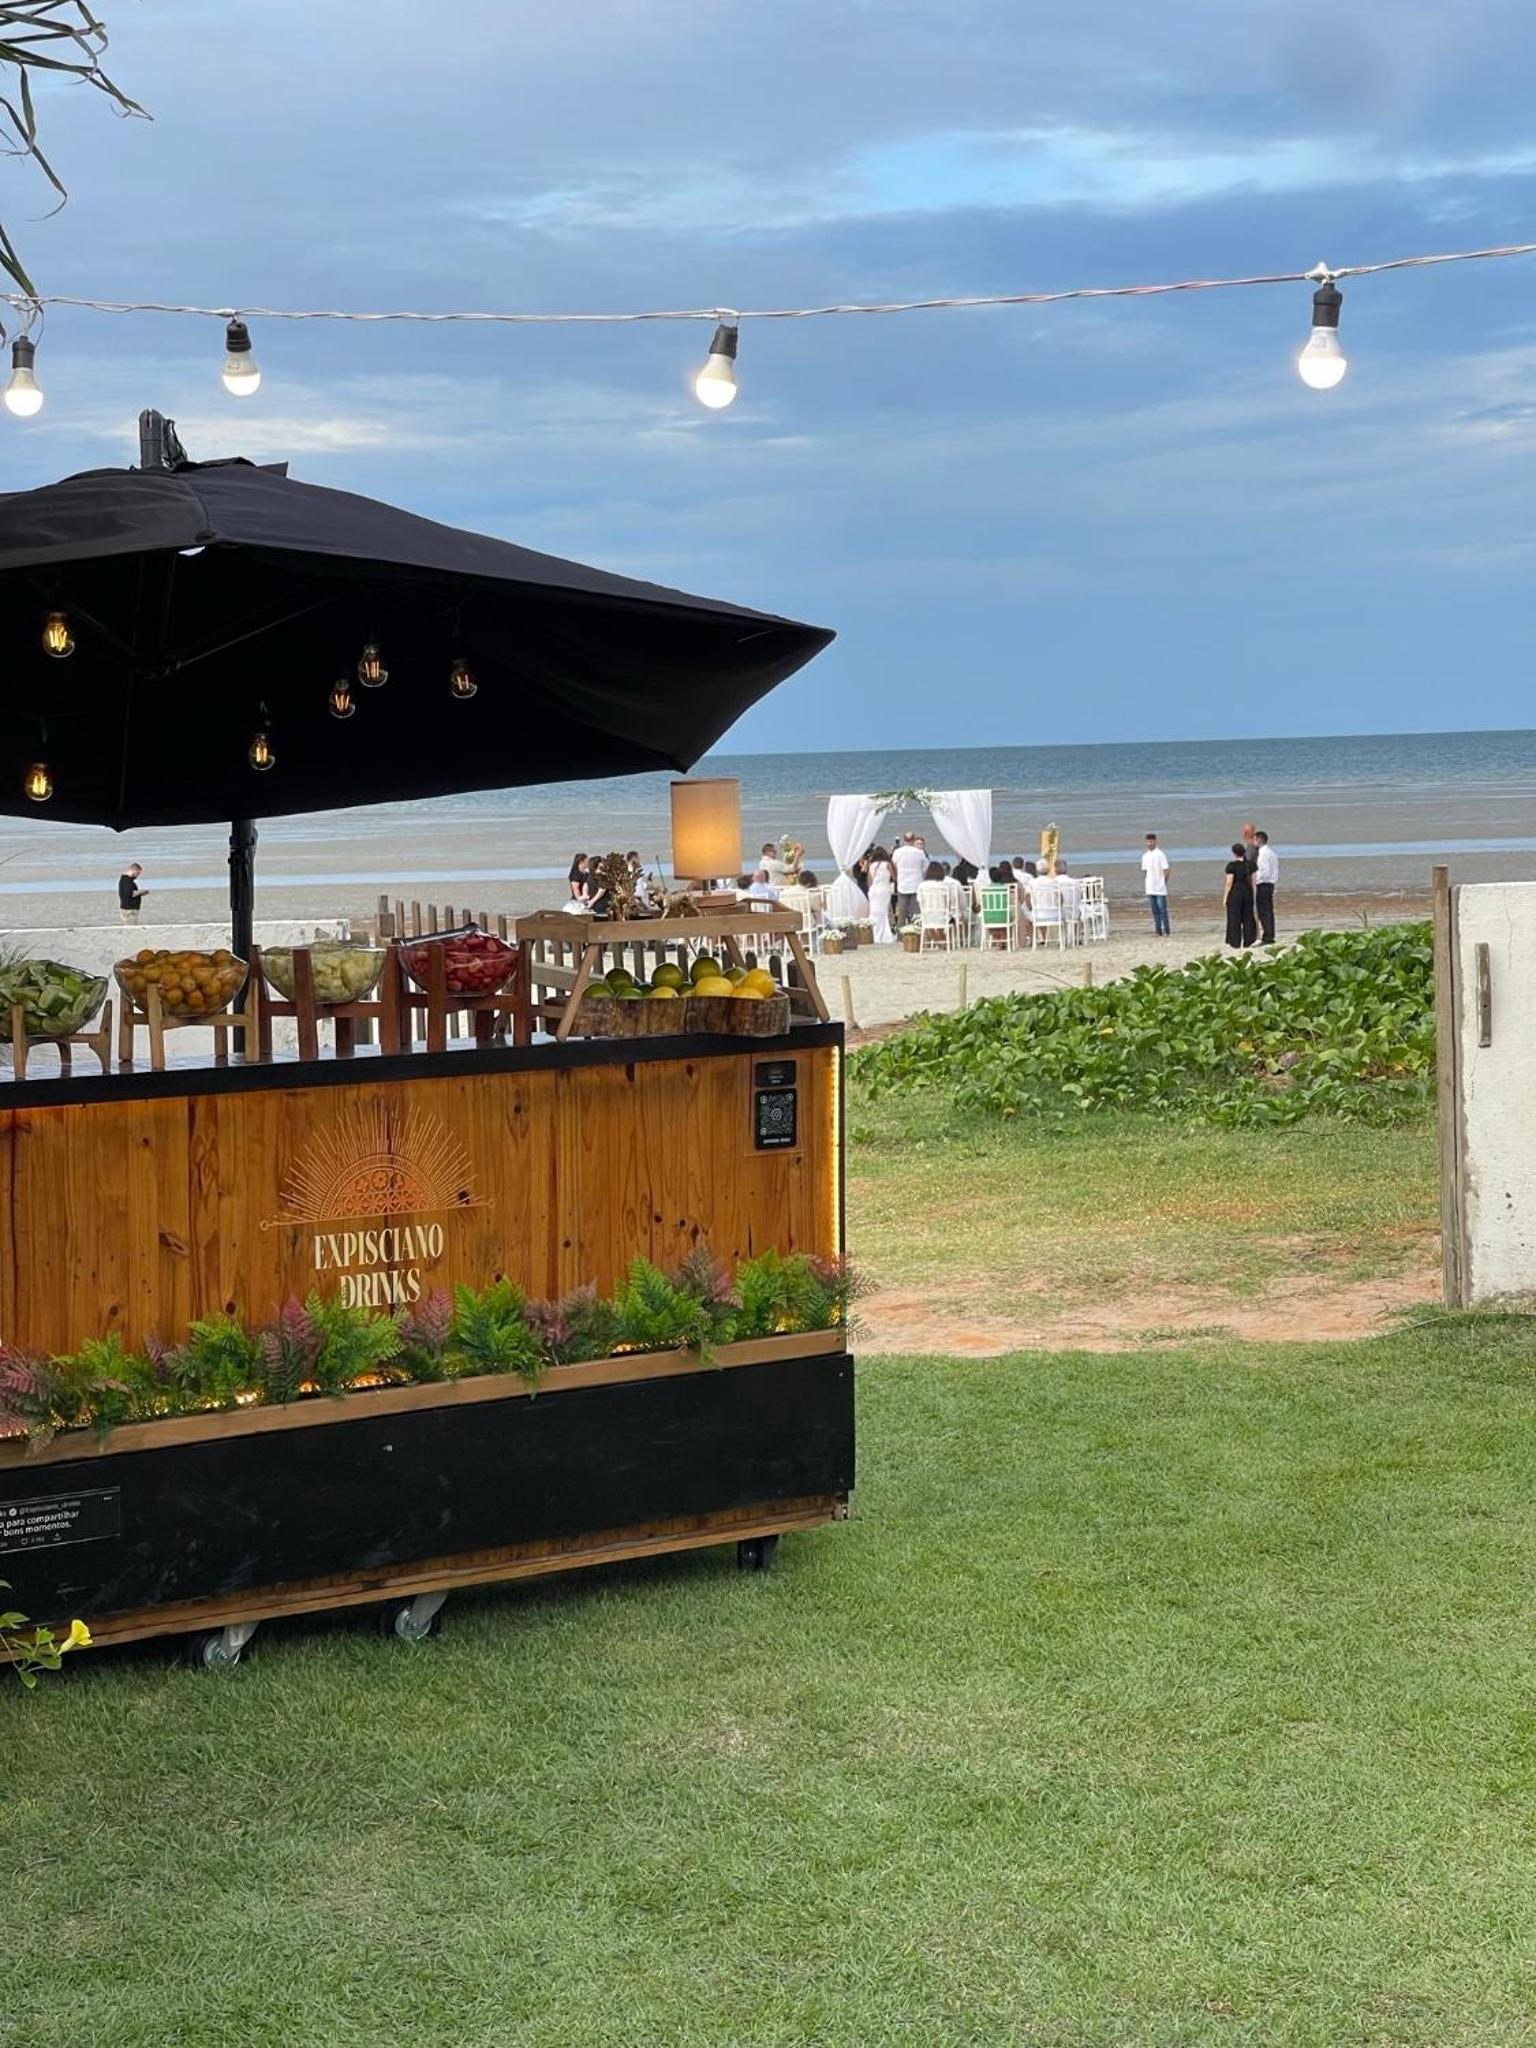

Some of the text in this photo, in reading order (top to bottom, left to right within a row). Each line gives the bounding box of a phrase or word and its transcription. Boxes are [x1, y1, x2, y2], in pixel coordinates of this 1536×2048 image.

[314, 1223, 444, 1269] EXPISCIANO
[340, 1268, 421, 1309] DRINKS
[3, 1526, 24, 1537] bons
[6, 1519, 25, 1528] para
[26, 1511, 79, 1524] compartilhar
